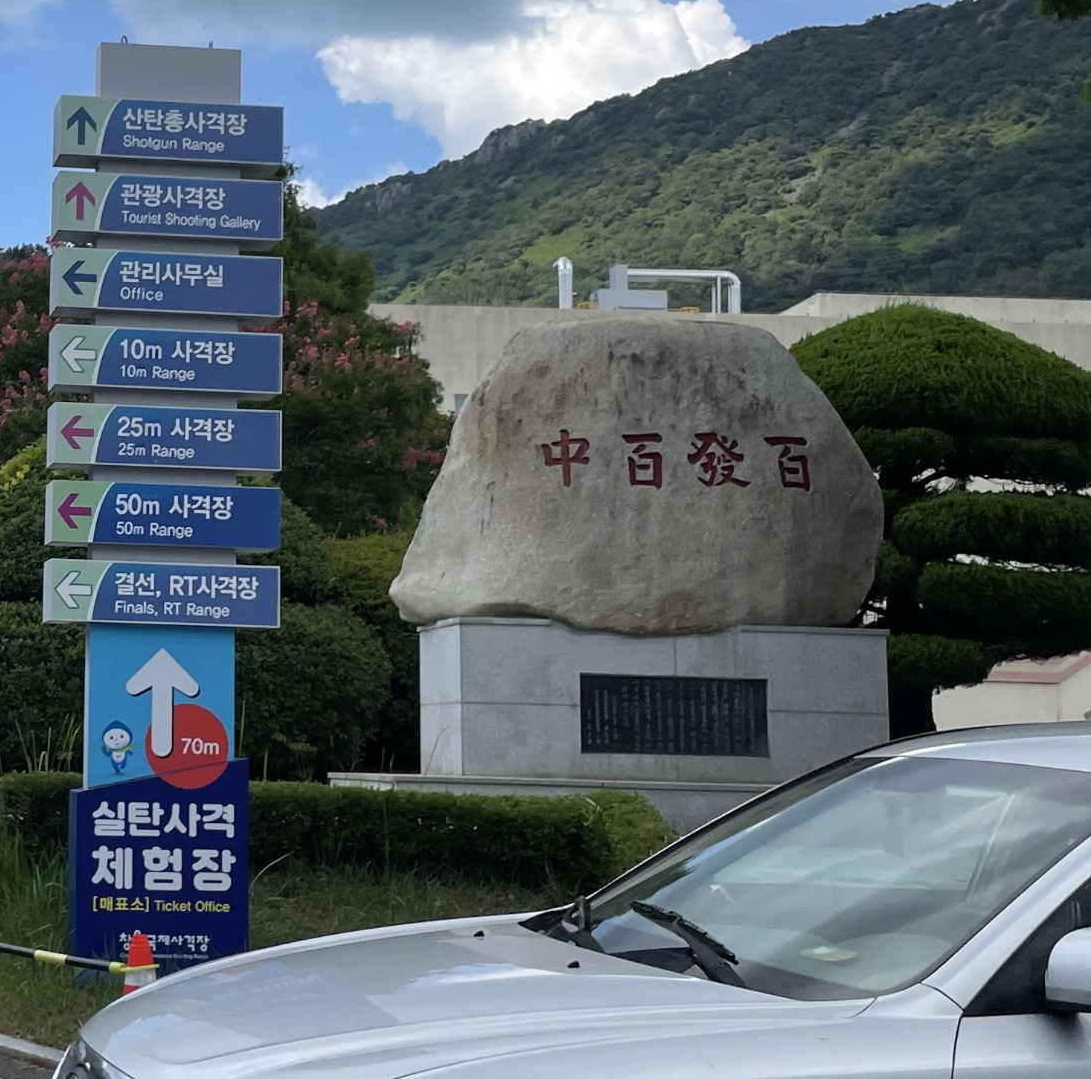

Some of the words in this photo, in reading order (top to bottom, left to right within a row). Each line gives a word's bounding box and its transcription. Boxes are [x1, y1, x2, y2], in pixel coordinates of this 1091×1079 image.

[122, 107, 247, 136] 산탄총사격장
[122, 135, 178, 151] Shotgun
[182, 137, 225, 153] Range
[120, 183, 226, 210] 관광사격장
[121, 210, 162, 225] Tourist
[165, 212, 216, 229] Shooting
[220, 215, 261, 232] Gallery
[119, 260, 224, 288] 관리사무실
[119, 286, 164, 301] Office
[119, 338, 163, 360] 10m
[171, 339, 235, 365] 사격장
[120, 364, 147, 378] 10m
[152, 365, 195, 381] Range
[116, 416, 162, 438] 25m
[170, 417, 235, 442] 사격장
[118, 443, 146, 456] 25m
[151, 444, 195, 460] Range
[115, 493, 160, 515] 50m
[168, 494, 234, 520] 사격장
[115, 521, 144, 535] 50m
[149, 523, 194, 539] Range
[114, 571, 161, 598] 결선,
[169, 575, 259, 600] RT사격장
[114, 600, 158, 616] Finals,
[163, 602, 182, 615] RT
[186, 603, 230, 618] Range
[180, 737, 220, 756] 70m
[91, 800, 235, 839] 실탄사격
[92, 895, 150, 913] [매표소]
[154, 899, 192, 912] Ticket
[195, 900, 231, 913] Office
[118, 929, 211, 953] 창국제사격장
